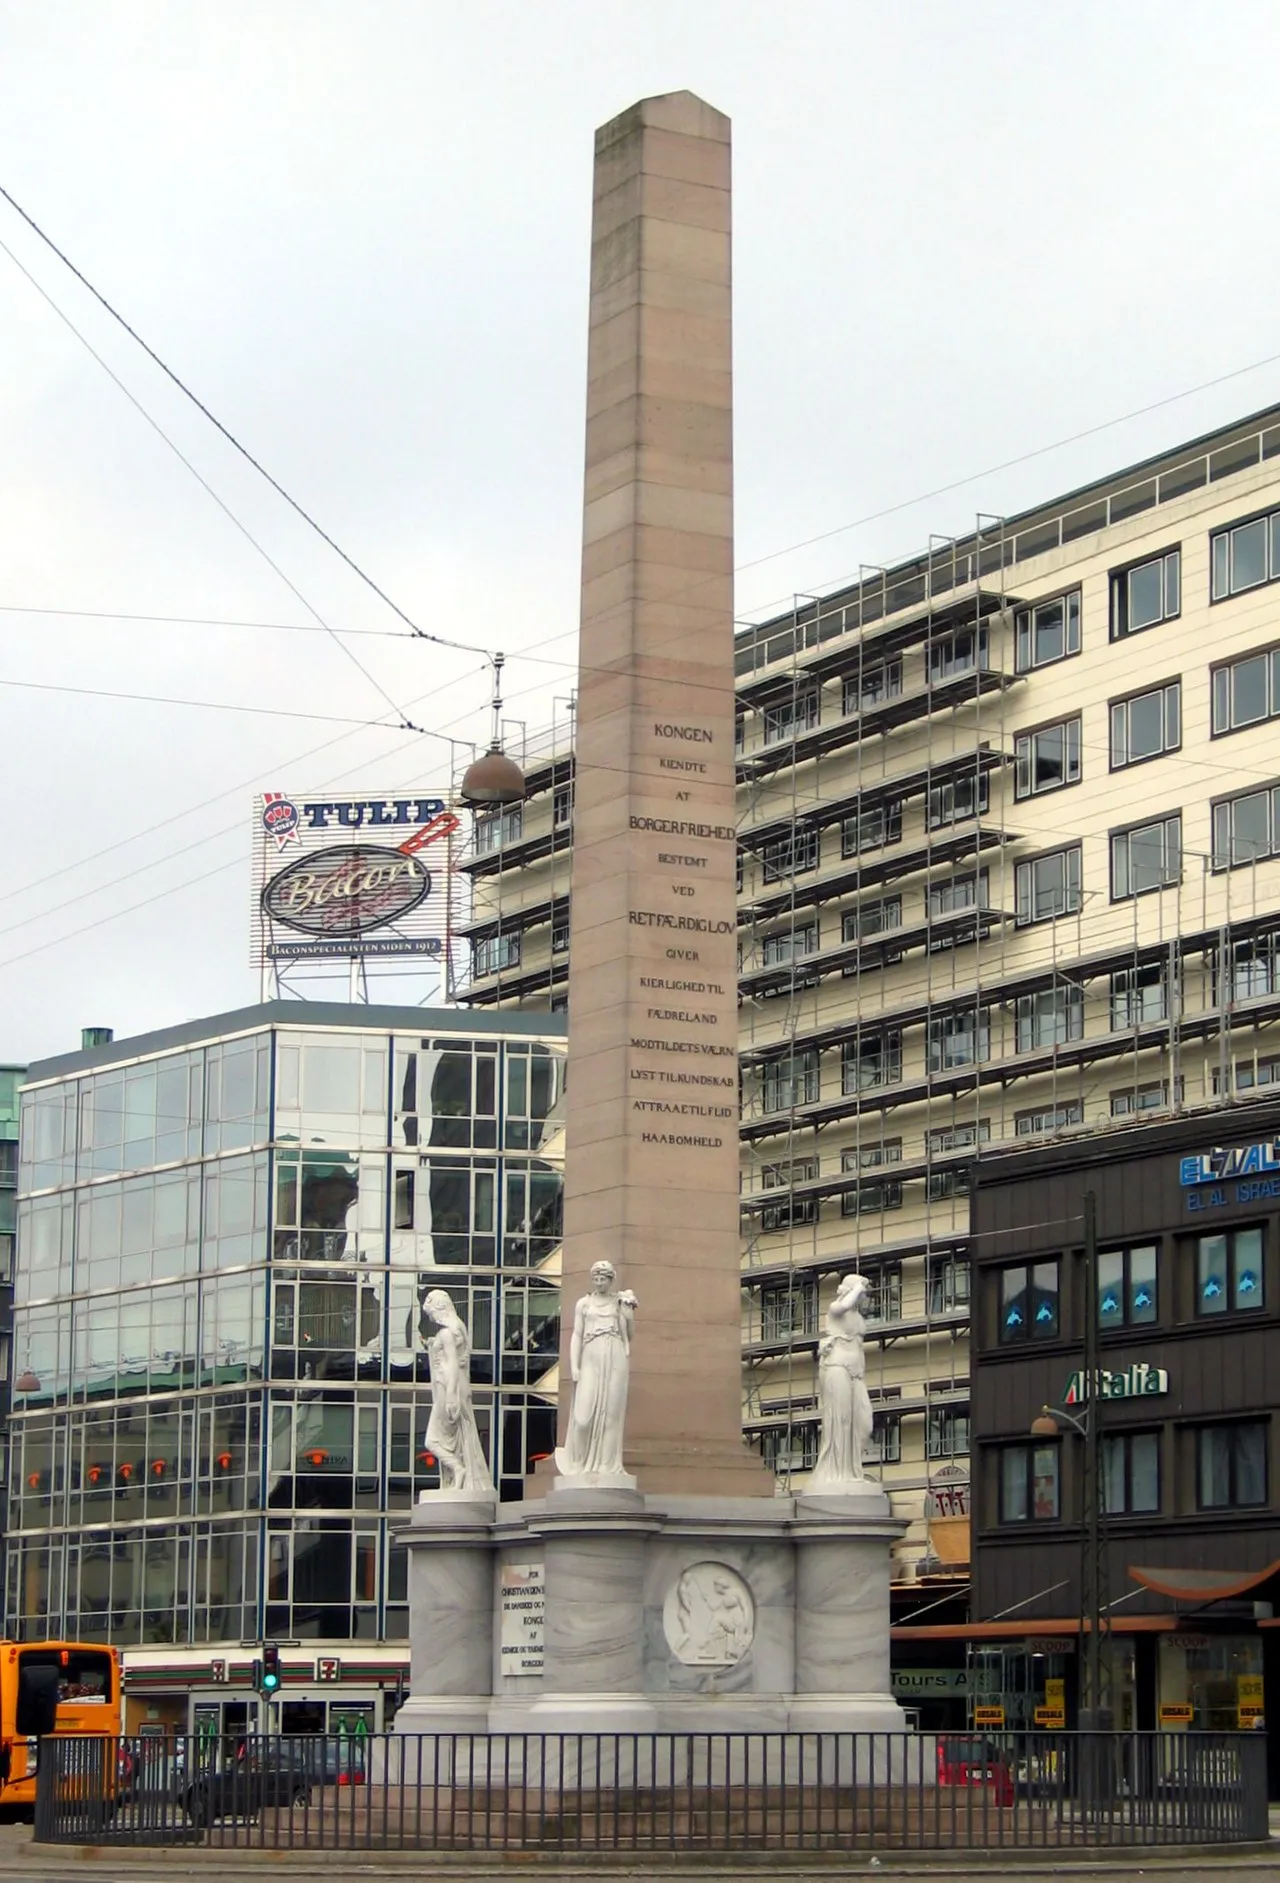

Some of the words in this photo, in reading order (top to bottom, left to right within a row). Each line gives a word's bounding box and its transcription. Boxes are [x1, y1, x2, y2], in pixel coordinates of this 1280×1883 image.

[654, 723, 713, 743] KONGEN
[659, 758, 707, 773] KIENDTE
[675, 791, 691, 801] AT
[304, 799, 445, 828] TULIP
[658, 853, 708, 868] BESTEMT
[272, 857, 427, 919] Bacon
[672, 885, 695, 897] VED
[415, 941, 437, 952] 1912
[666, 949, 699, 960] GIVER
[640, 977, 705, 993] KIERLIGHED
[707, 983, 725, 995] TIL
[647, 1008, 718, 1025] FÆDRELAND
[630, 1069, 657, 1080] LYST
[1187, 1191, 1207, 1210] EL
[1210, 1188, 1229, 1206] AL
[1236, 1178, 1280, 1203] ISRAE
[1031, 1640, 1071, 1652] SCOOP
[891, 1672, 947, 1687] Tours
